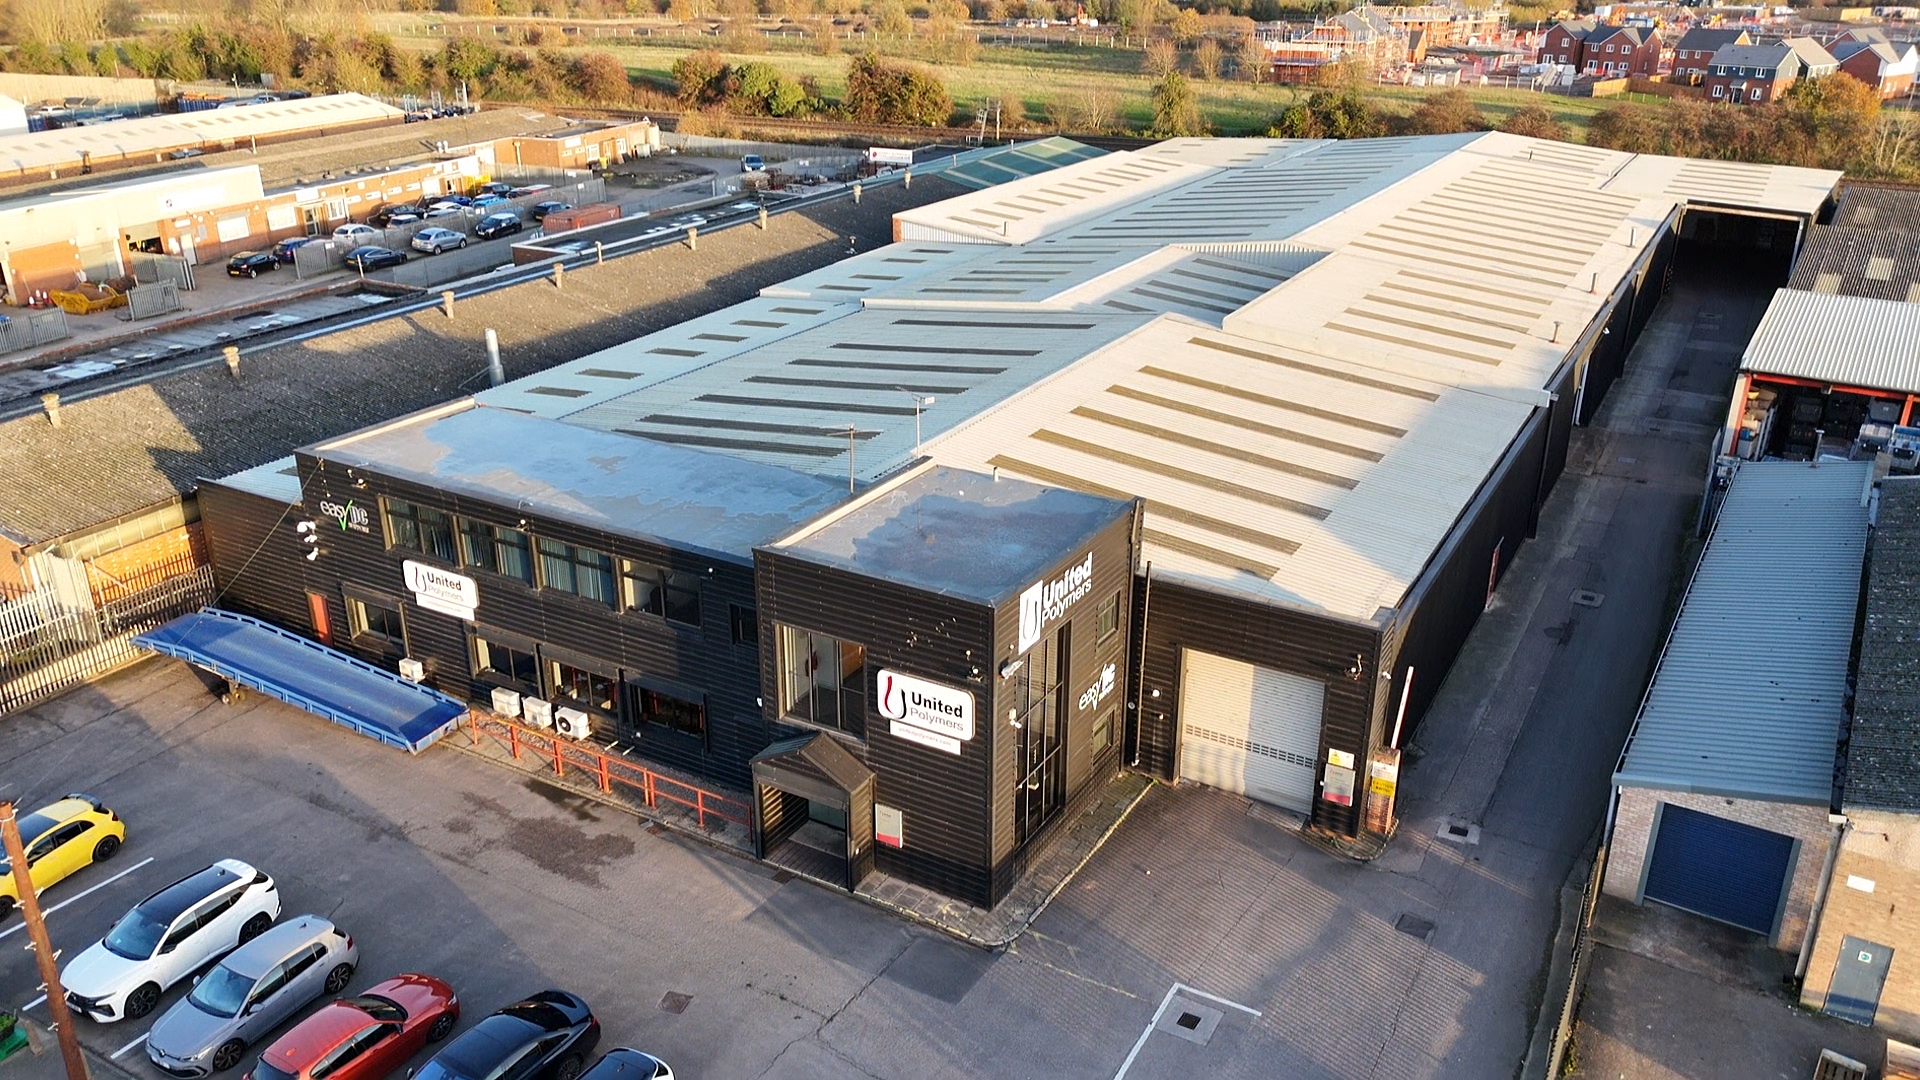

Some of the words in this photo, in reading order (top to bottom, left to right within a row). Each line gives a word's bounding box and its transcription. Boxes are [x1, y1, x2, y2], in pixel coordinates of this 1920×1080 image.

[427, 571, 462, 591] United
[1043, 551, 1093, 609] United
[1042, 578, 1092, 628] Polymers
[911, 691, 963, 718] United
[910, 707, 964, 731] Polymers
